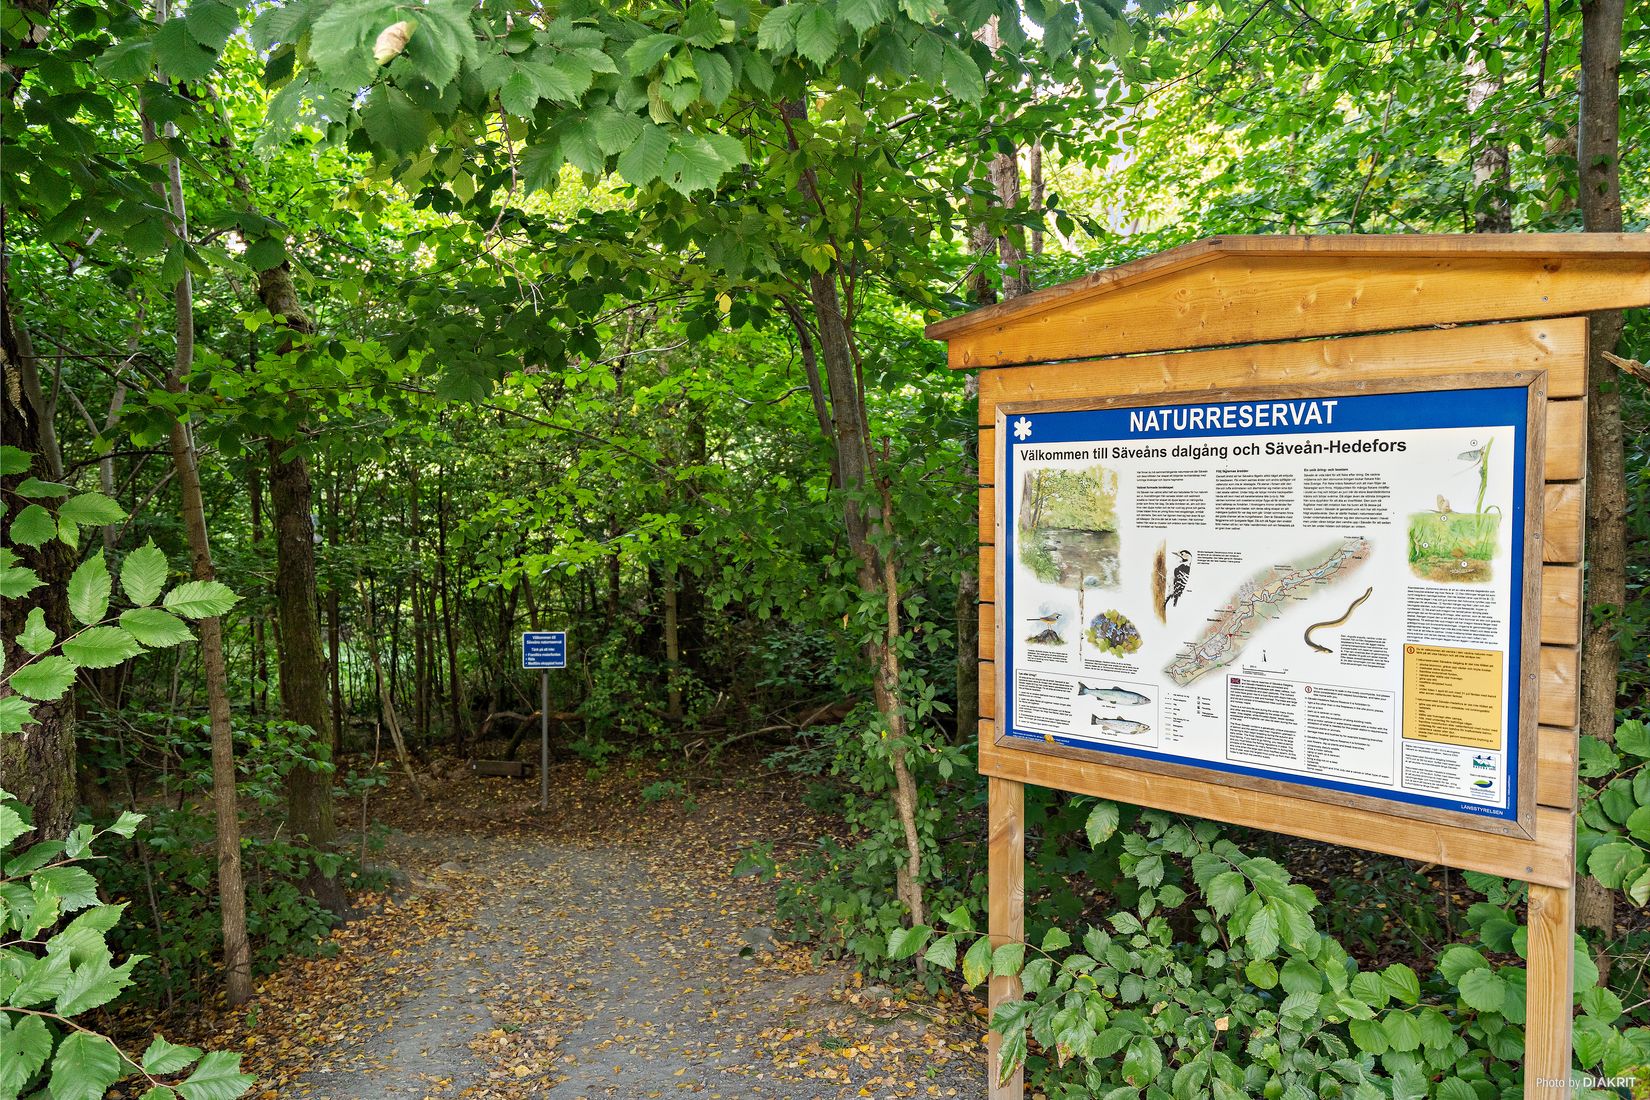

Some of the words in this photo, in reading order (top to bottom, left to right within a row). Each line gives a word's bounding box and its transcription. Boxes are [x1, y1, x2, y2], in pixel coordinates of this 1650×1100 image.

[1129, 400, 1338, 433] NATURRESERVAT
[1020, 449, 1089, 461] Välkommen
[1093, 447, 1109, 460] till
[1112, 444, 1168, 459] Säveåns
[1171, 443, 1229, 460] dalgång
[1232, 442, 1261, 456] och
[1265, 438, 1408, 455] Säveån-Hedefors
